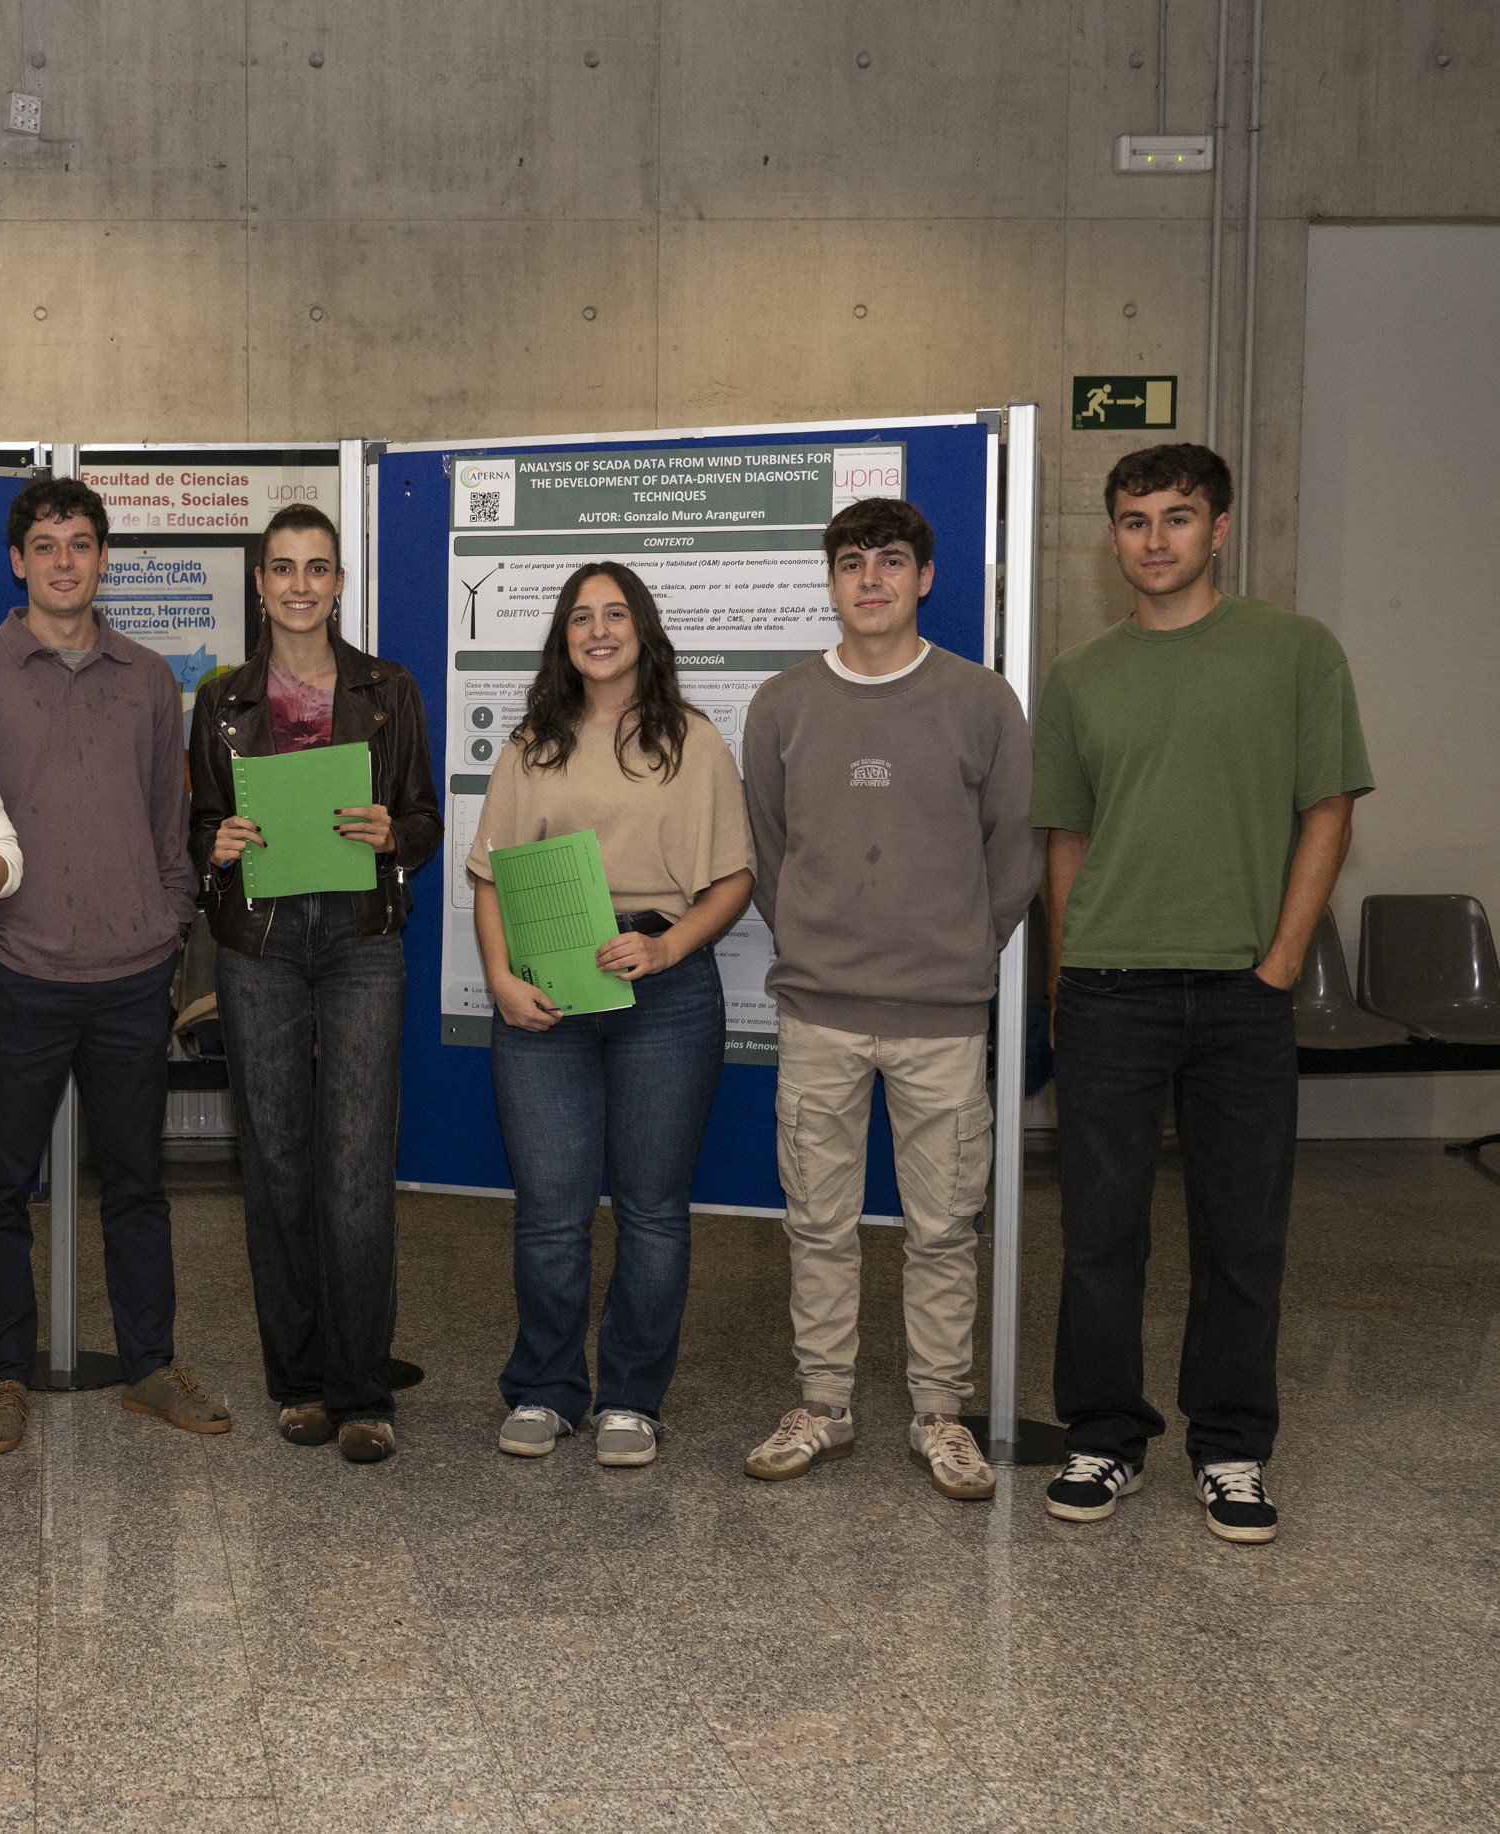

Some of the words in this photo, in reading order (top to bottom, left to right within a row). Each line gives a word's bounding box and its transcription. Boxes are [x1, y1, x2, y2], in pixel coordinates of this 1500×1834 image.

[519, 461, 571, 473] ANALYSIS
[574, 461, 590, 471] OF
[592, 460, 631, 471] SCADA
[634, 459, 666, 470] DATA
[669, 457, 704, 468] FROM
[707, 456, 742, 467] WIND
[745, 454, 804, 466] TURBINES
[807, 453, 832, 464] FOR
[80, 472, 150, 486] Facultad
[156, 472, 174, 486] de
[180, 472, 249, 486] Ciencias
[469, 471, 511, 481] APERNA
[531, 478, 552, 489] THE
[554, 476, 640, 488] DEVELOPMENT
[642, 476, 658, 486] OF
[661, 472, 741, 485] DATA-DRIVEN
[744, 470, 819, 483] DIAGNOSTIC
[834, 468, 900, 492] upna
[182, 492, 249, 506] Sociales
[267, 484, 319, 504] upna
[633, 490, 707, 503] TECHNIQUES
[122, 514, 141, 527] de
[147, 513, 161, 527] la
[167, 513, 249, 527] Educación
[578, 512, 621, 523] AUTOR:
[624, 510, 669, 522] Gonzalo
[672, 510, 703, 521] Muro
[706, 508, 765, 522] Aranguren
[643, 537, 695, 547] CONTEXTO
[107, 562, 144, 574] ngua,
[146, 560, 202, 573] Acogida
[532, 563, 555, 571] parque
[627, 560, 658, 568] eficiencia
[698, 559, 720, 568] (O&M)
[98, 573, 163, 586] Migración
[166, 572, 207, 586] (LAM)
[661, 583, 687, 591] clásica,
[752, 583, 775, 591] puede
[158, 605, 210, 616] Harrera
[497, 609, 540, 618] OBJETIVO
[172, 616, 216, 630] (HHM)
[674, 655, 725, 665] ODOLOGÍA
